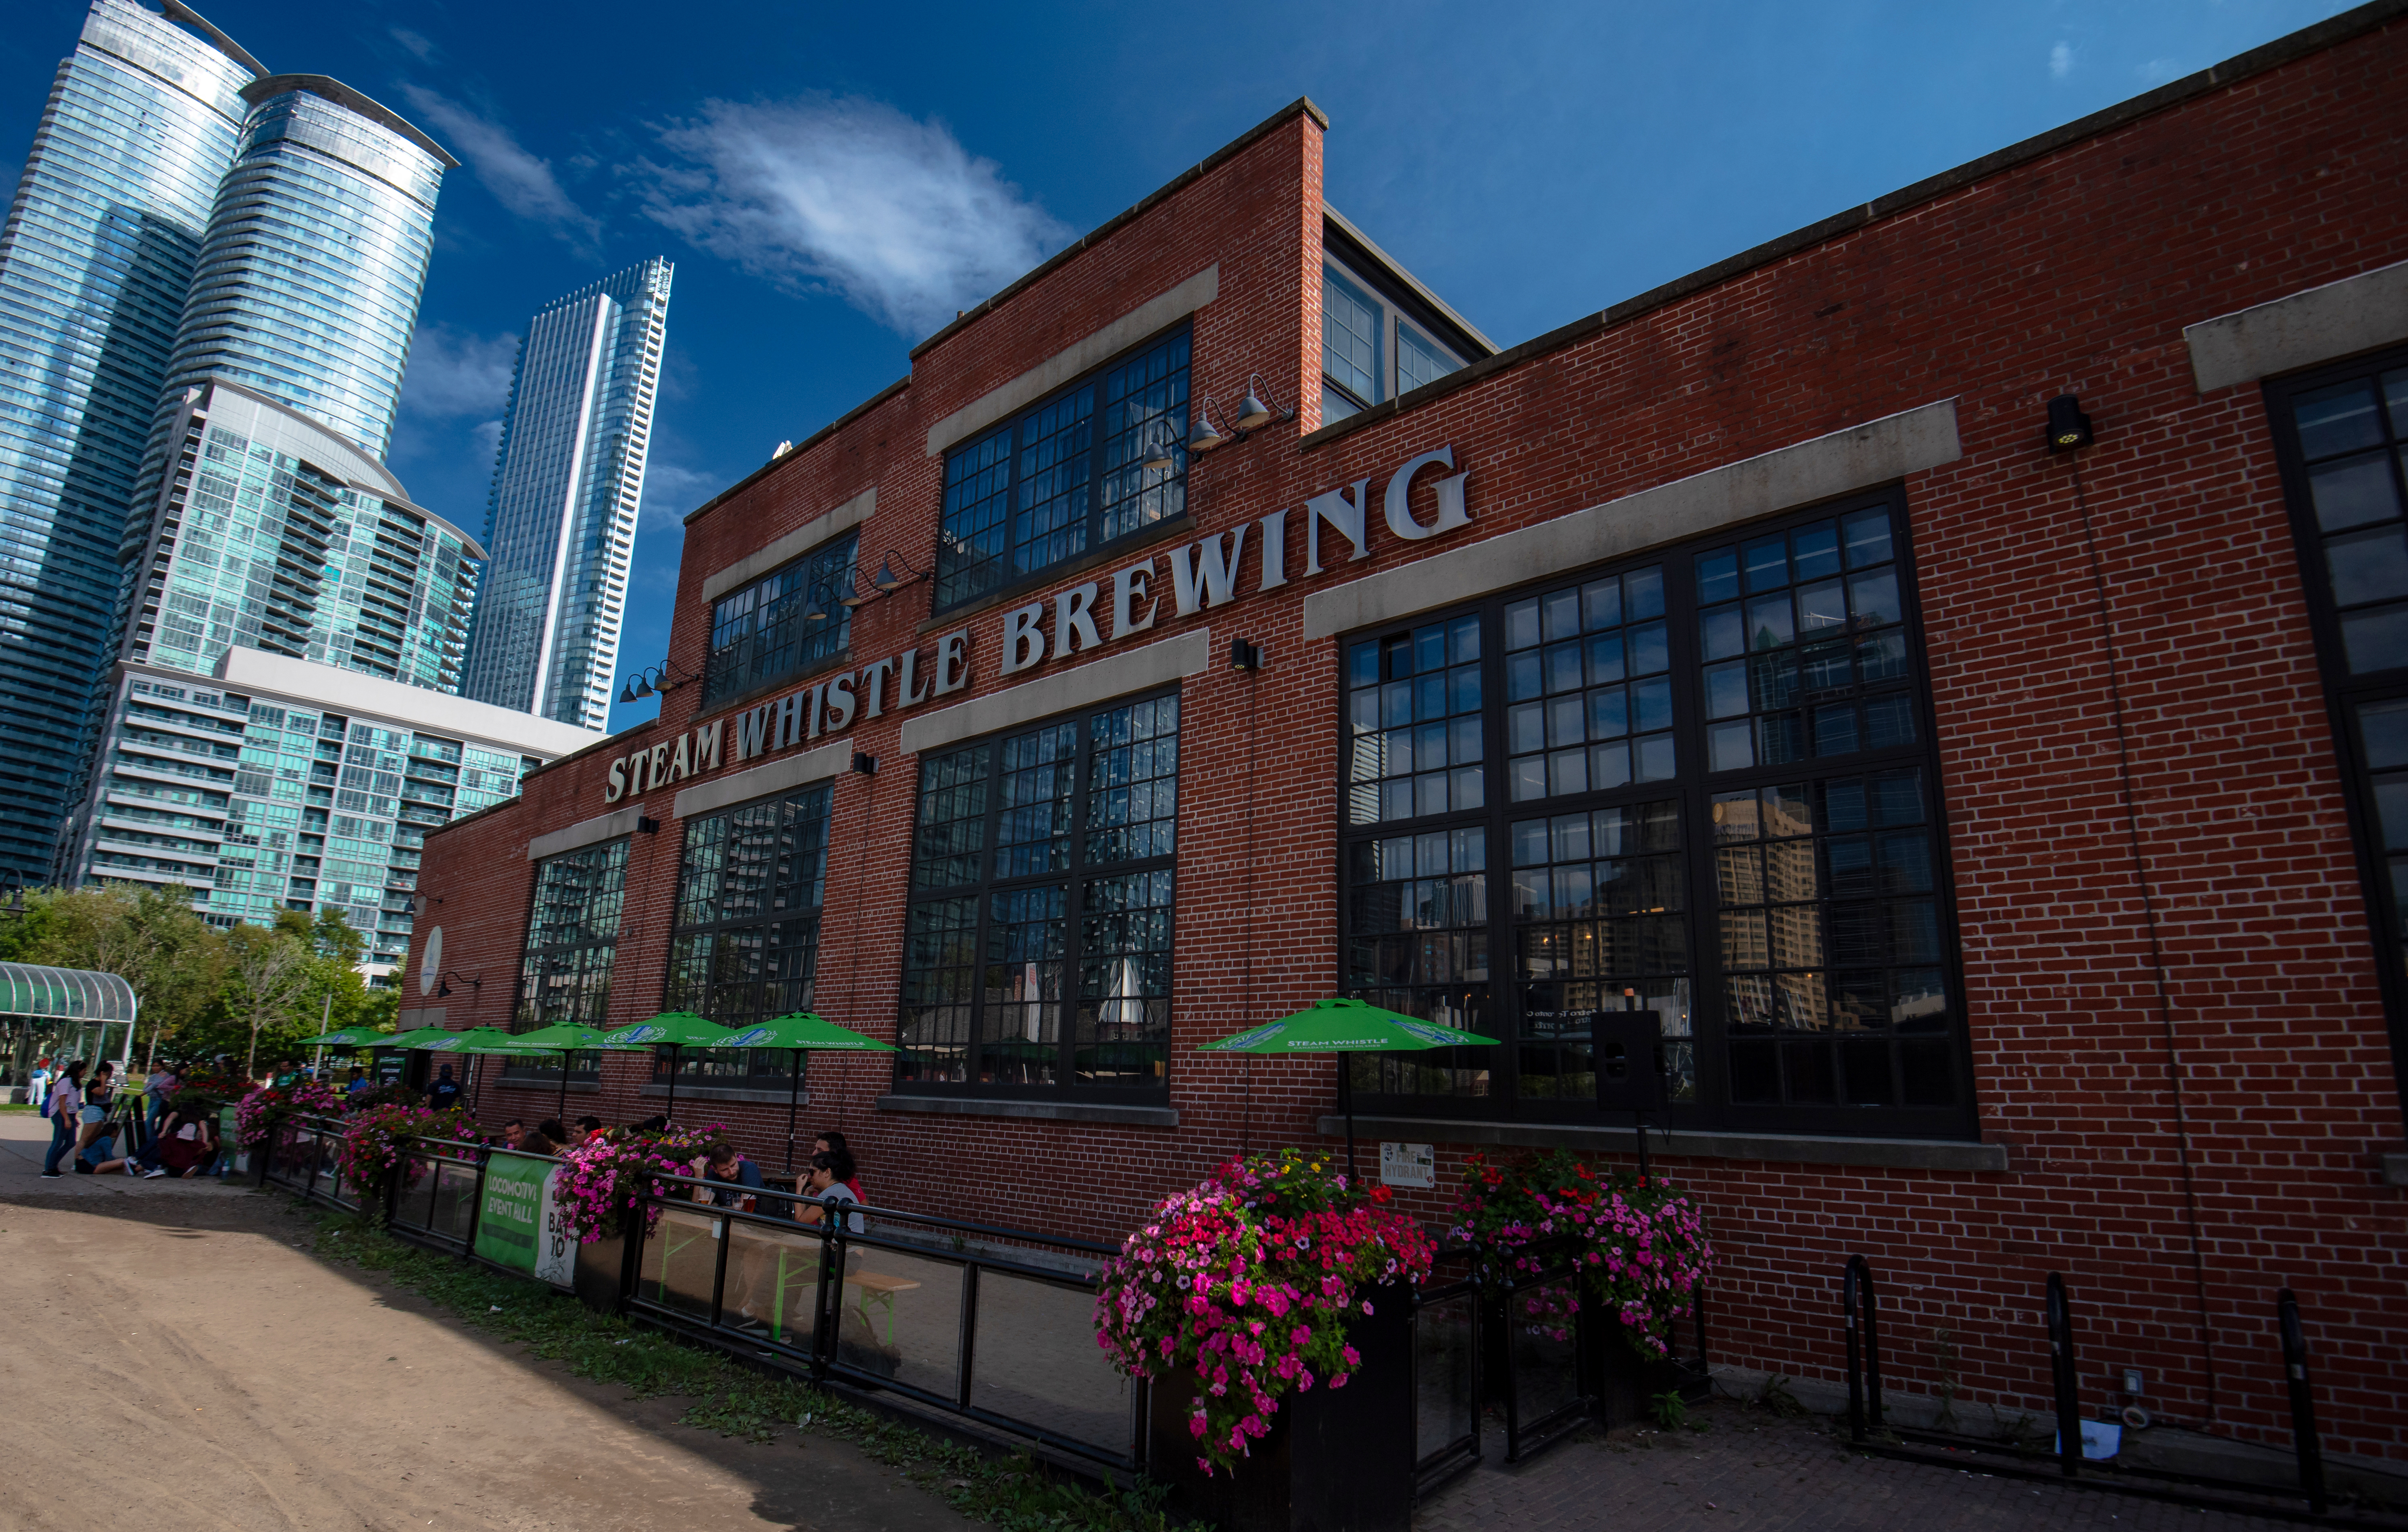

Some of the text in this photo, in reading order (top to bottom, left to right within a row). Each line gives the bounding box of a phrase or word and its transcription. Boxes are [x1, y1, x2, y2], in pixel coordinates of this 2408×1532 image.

[605, 443, 1473, 803] STEAM WHISTLE BREWING
[1396, 1149, 1416, 1164] FIRE
[1385, 1164, 1429, 1179] HYDRANT
[488, 1175, 537, 1202] LOCOMOTIVE
[488, 1197, 533, 1224] EVENT HALL
[551, 1235, 565, 1258] 10
